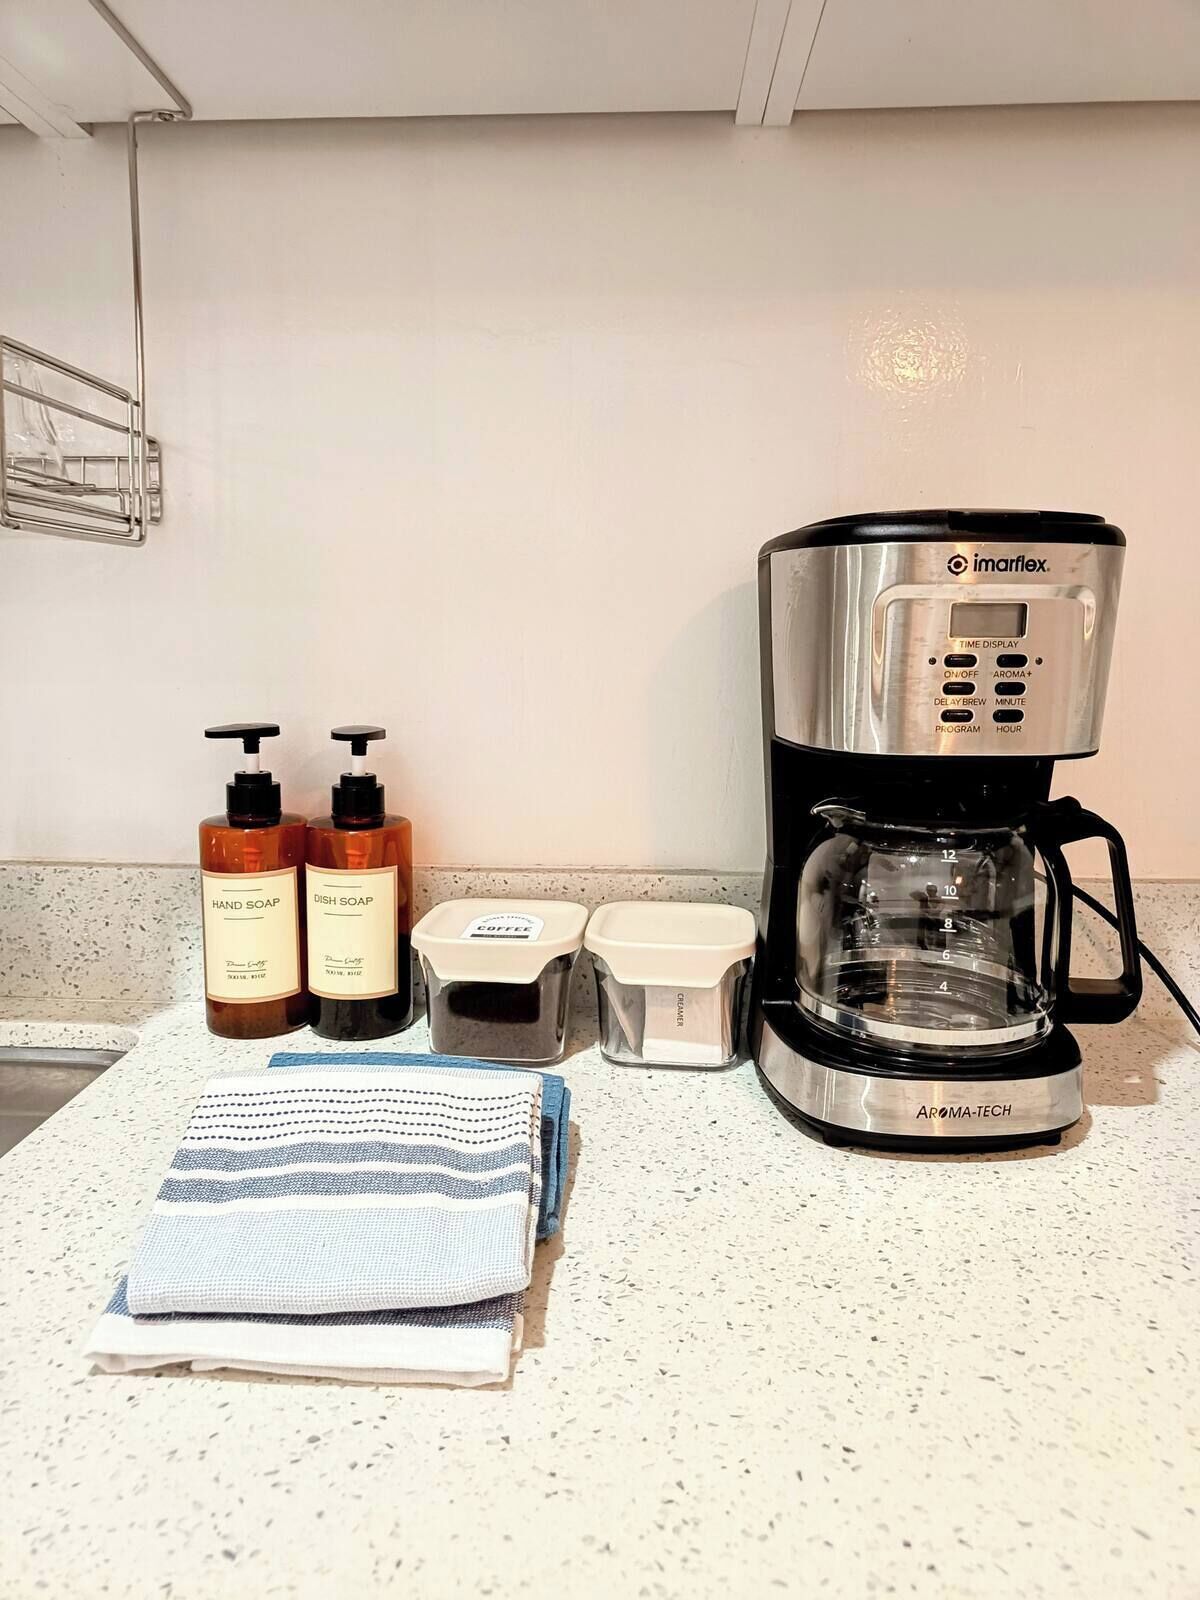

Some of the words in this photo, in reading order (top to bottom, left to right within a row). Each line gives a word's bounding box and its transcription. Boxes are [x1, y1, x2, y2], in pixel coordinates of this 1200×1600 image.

[973, 552, 1048, 573] imarflex
[960, 641, 981, 649] TIME
[982, 641, 1019, 649] DISPLAY
[943, 670, 980, 679] ON/OFF
[993, 670, 1032, 679] AROMA+
[934, 698, 961, 706] DELAY
[962, 698, 987, 706] BREW
[995, 698, 1026, 706] MINUTE
[935, 725, 981, 734] PROGRAM
[996, 725, 1023, 734] HOUR
[942, 850, 956, 860] 12
[943, 885, 957, 896] 10
[212, 900, 243, 910] HAND
[246, 897, 281, 910] SOAP
[314, 894, 337, 906] DISH
[339, 896, 374, 906] SOAP
[944, 918, 953, 929] 8
[942, 950, 950, 960] 6
[939, 981, 948, 992] 4
[676, 992, 685, 1027] CREAMER
[916, 1104, 1012, 1119] AROMA-TECH
